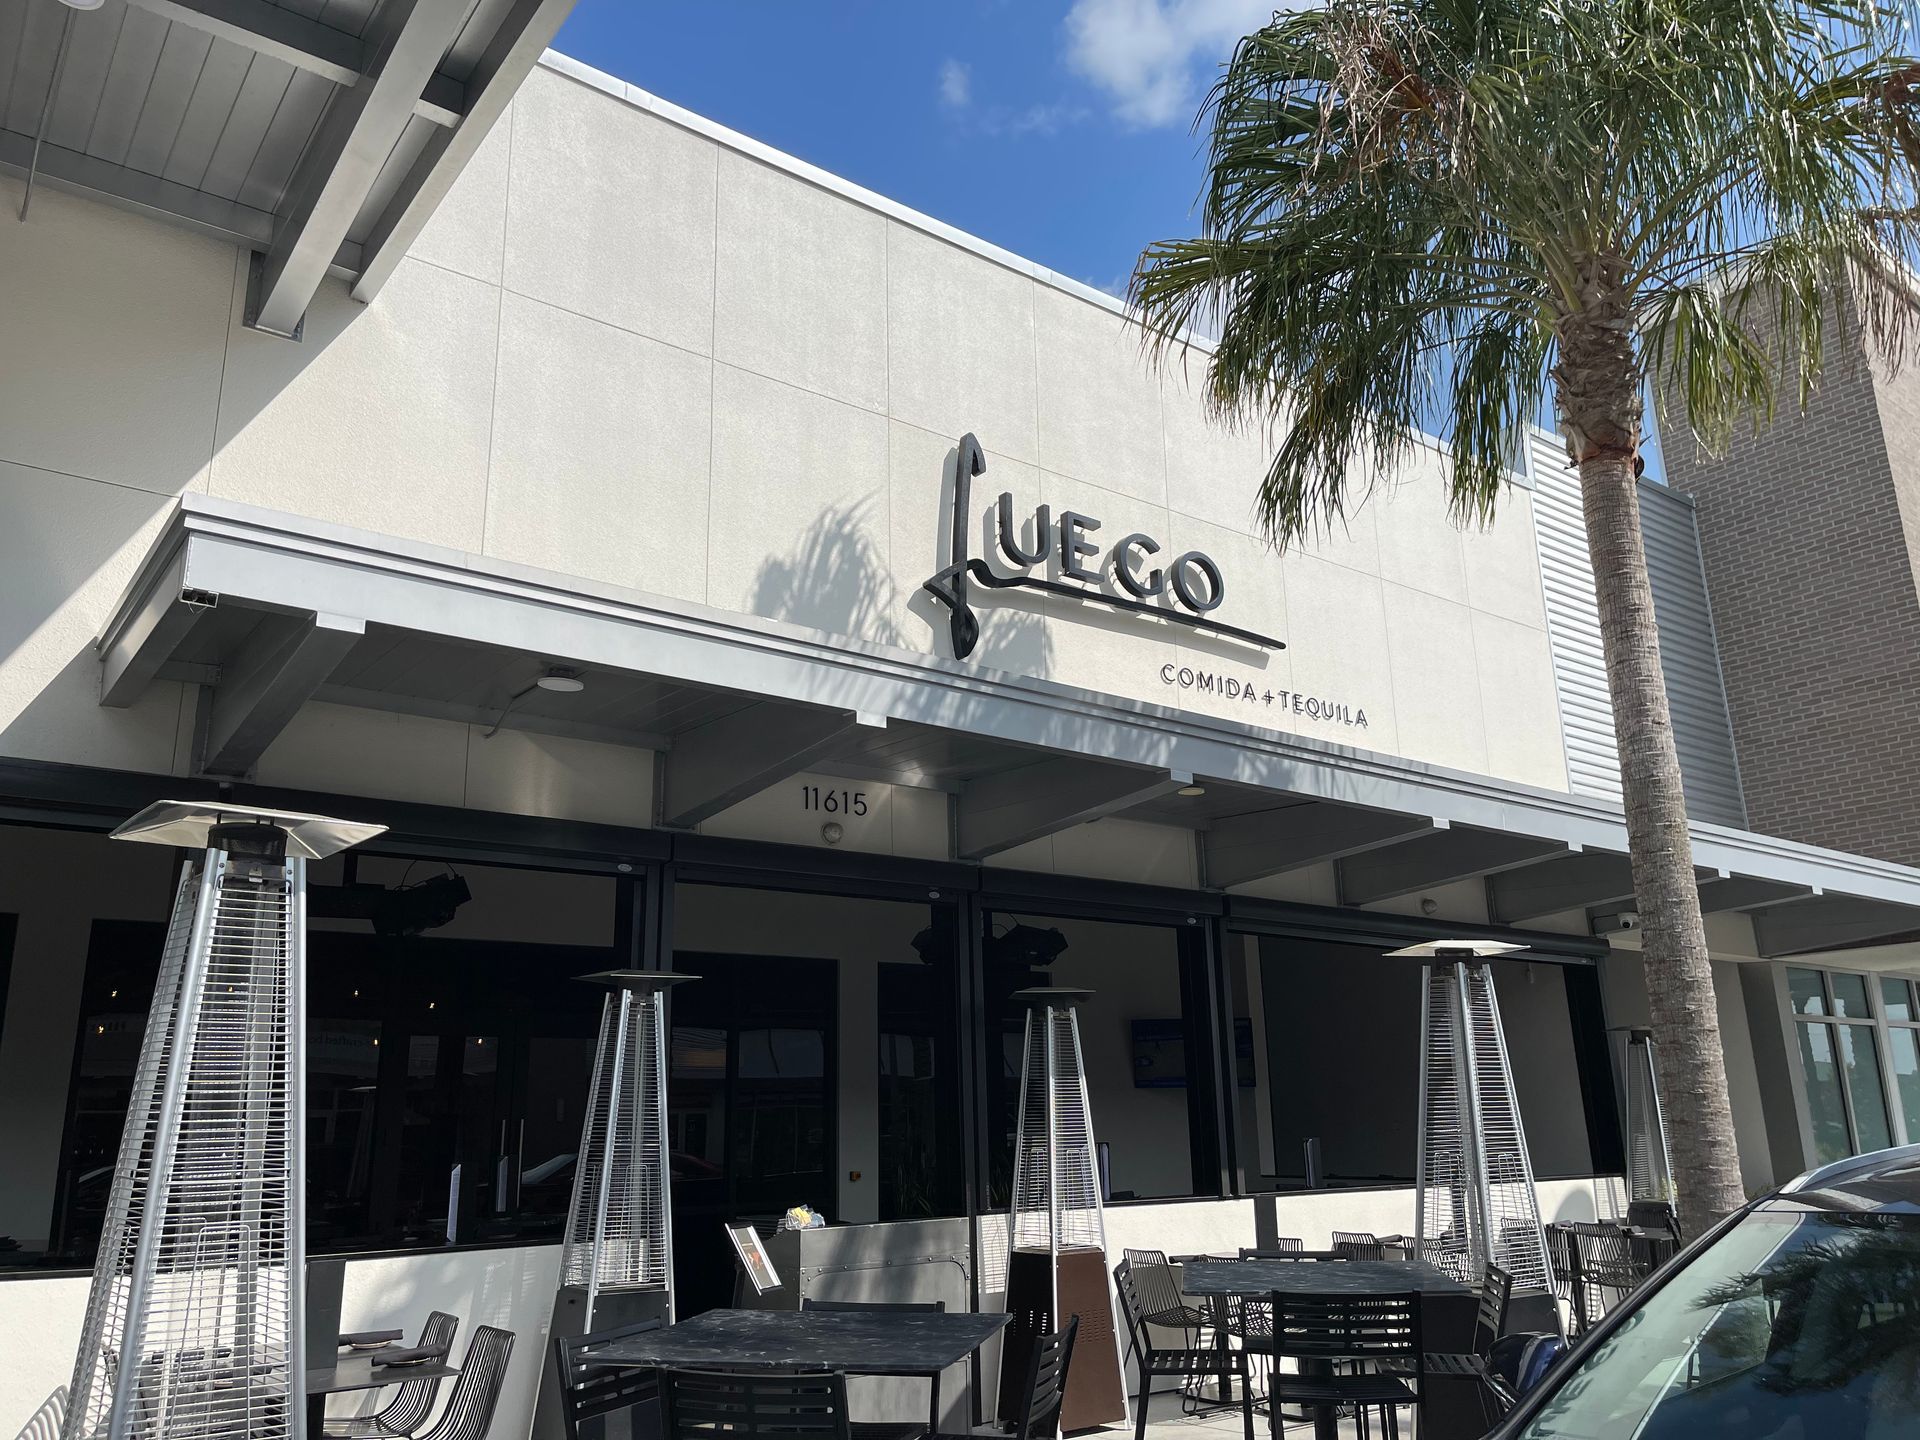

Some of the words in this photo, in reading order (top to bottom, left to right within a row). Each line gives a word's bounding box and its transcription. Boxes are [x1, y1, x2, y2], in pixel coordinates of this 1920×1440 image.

[1161, 663, 1257, 702] COMIDA
[1280, 690, 1369, 727] TEQUILA
[802, 785, 868, 817] 11615
